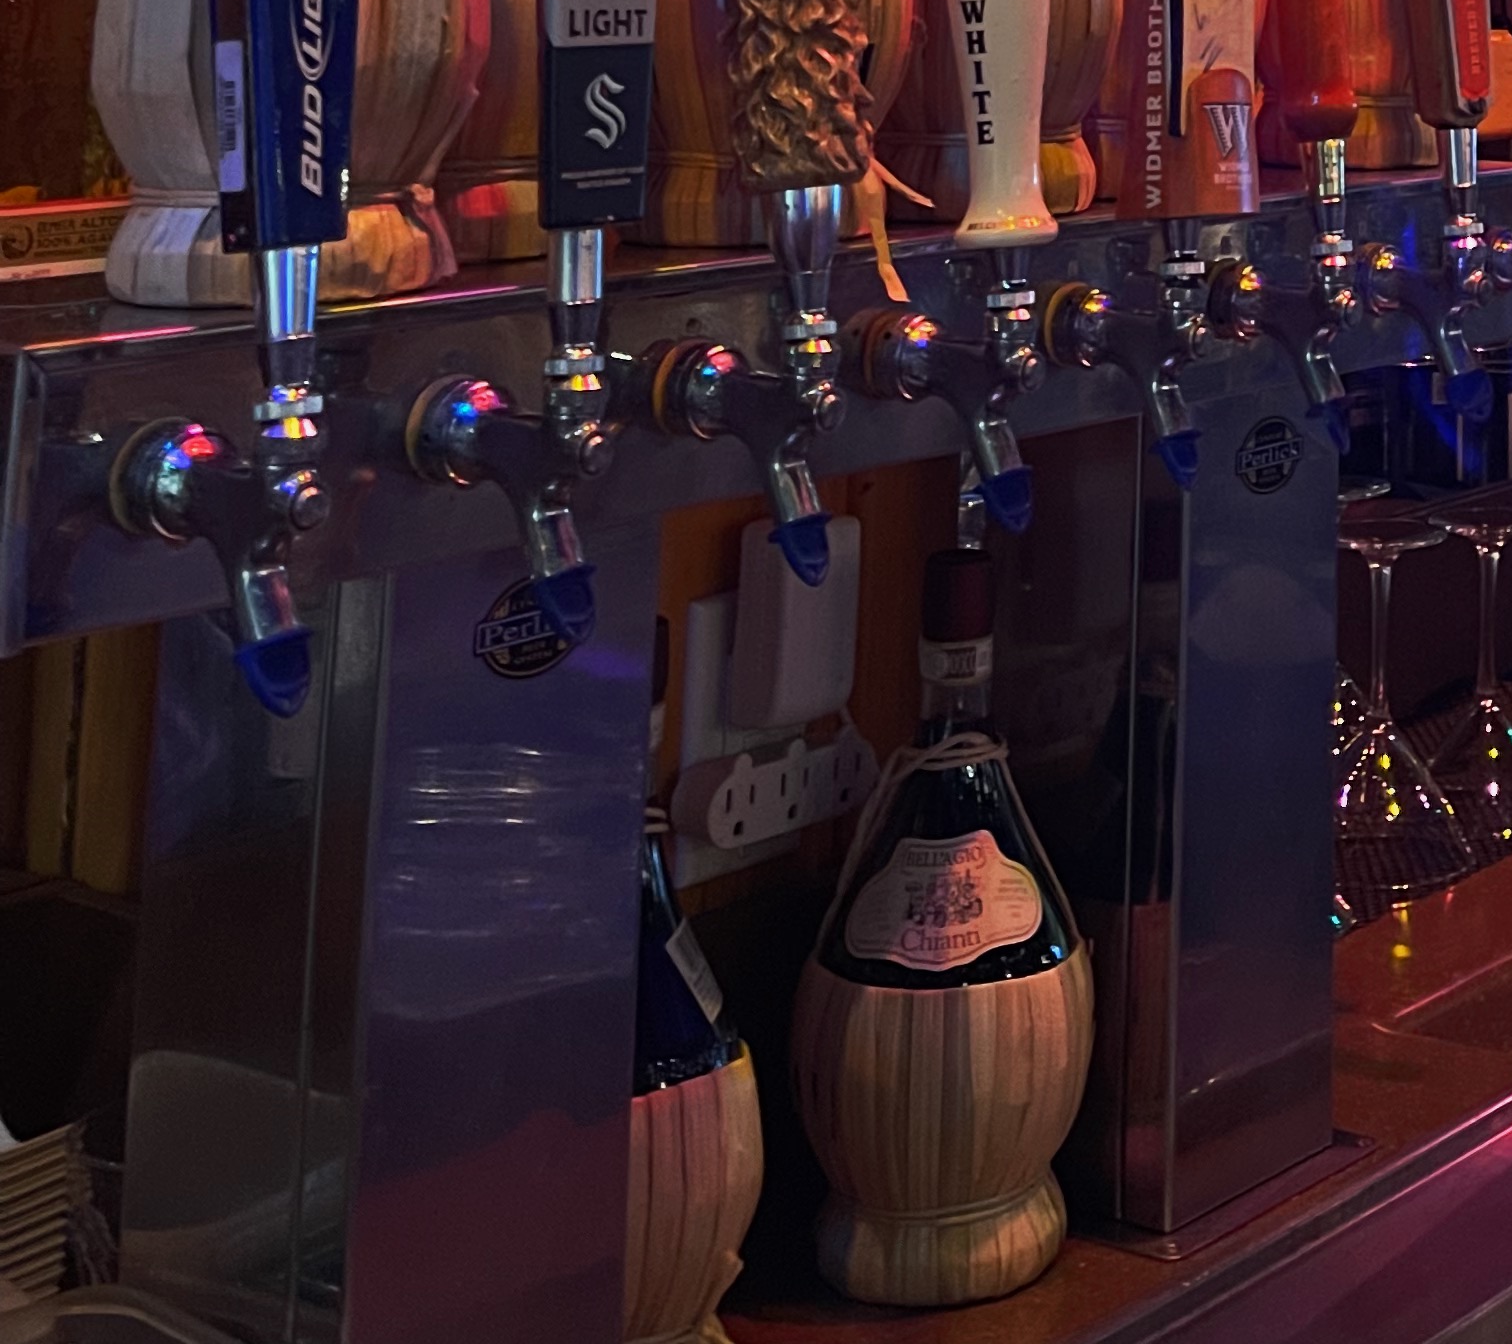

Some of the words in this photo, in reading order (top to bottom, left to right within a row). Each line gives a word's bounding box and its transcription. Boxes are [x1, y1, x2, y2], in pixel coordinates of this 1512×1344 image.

[568, 8, 648, 38] LIGHT
[301, 83, 324, 199] BUD
[1145, 94, 1163, 209] WIDMER
